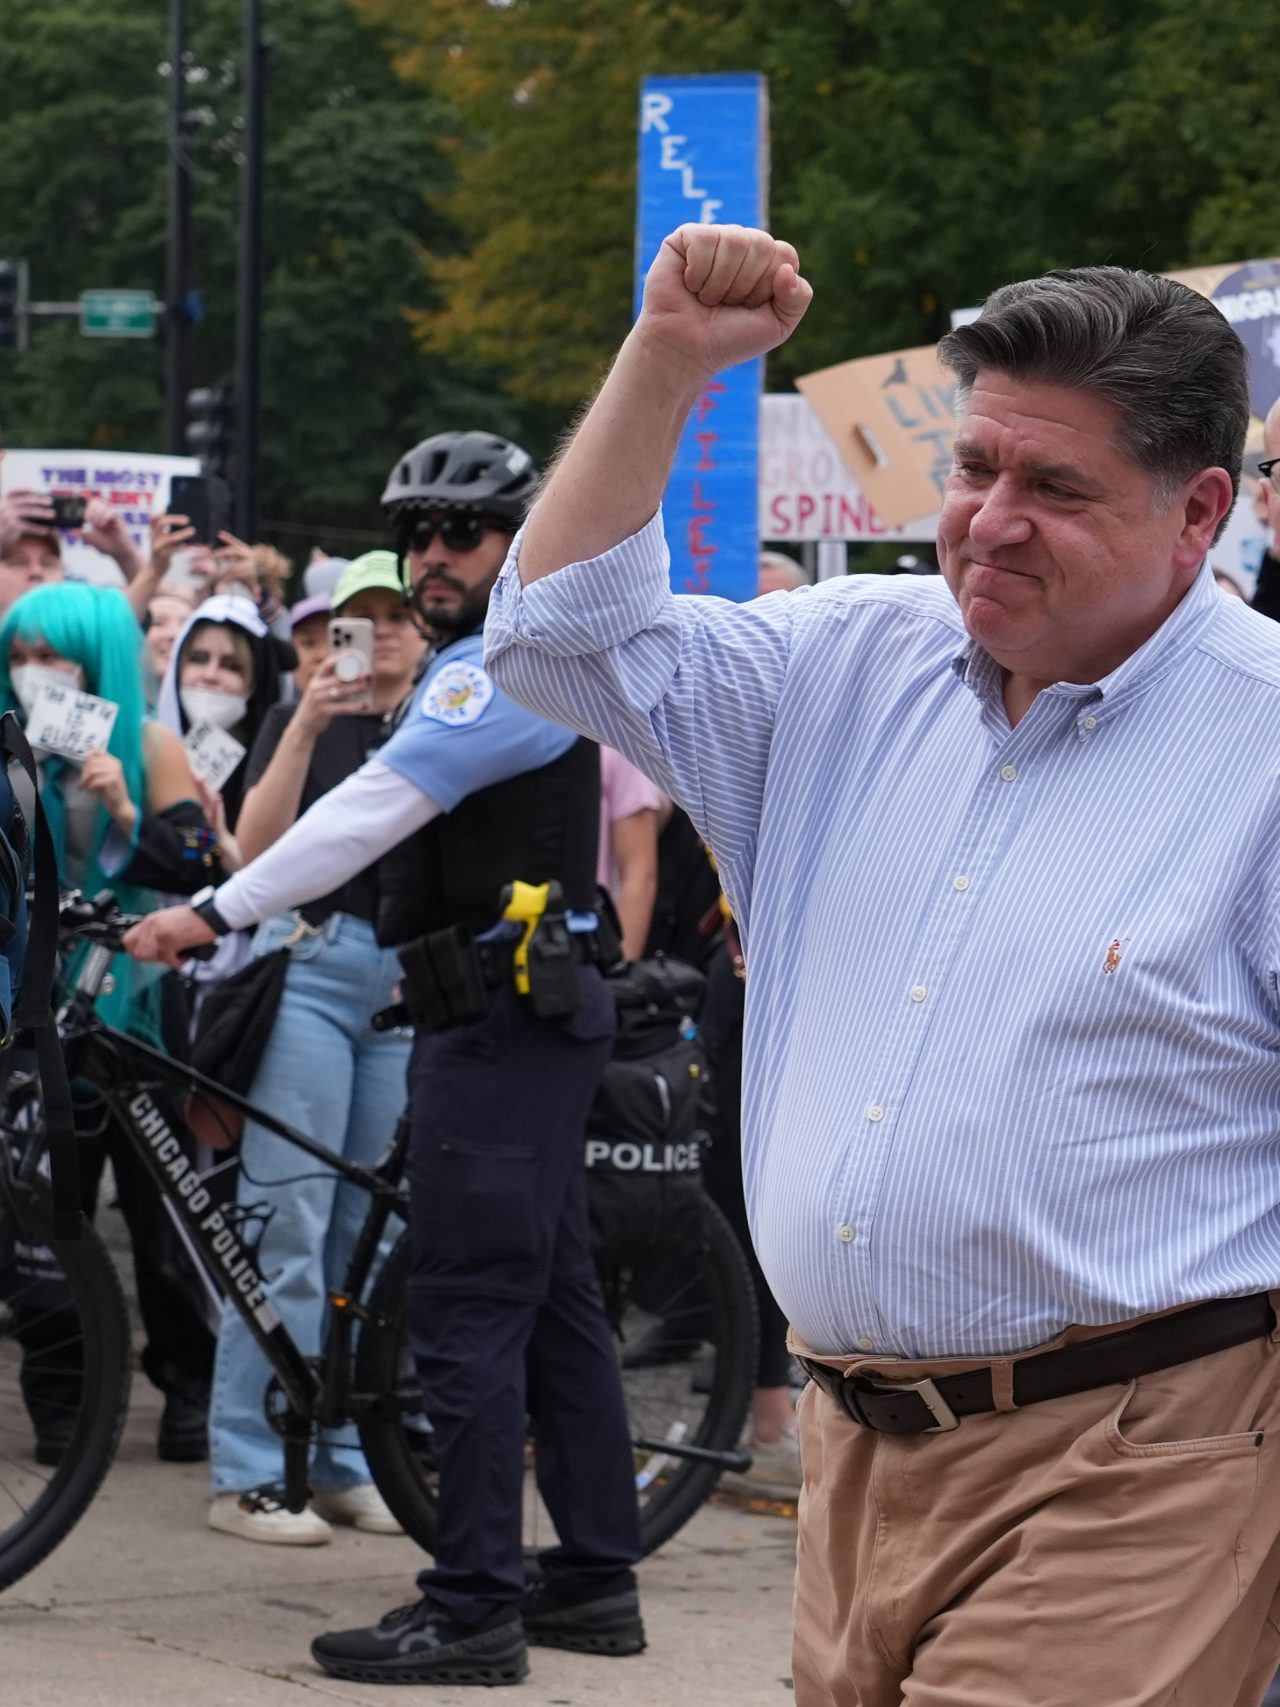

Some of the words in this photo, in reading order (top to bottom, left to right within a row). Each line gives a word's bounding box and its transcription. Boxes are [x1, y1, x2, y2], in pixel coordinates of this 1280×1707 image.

[641, 92, 723, 224] RELE
[762, 447, 834, 488] GRO
[770, 493, 903, 535] SPINE
[584, 1140, 701, 1172] POLICE
[129, 1092, 211, 1214] CHICAGO
[200, 1210, 268, 1309] POLICE
